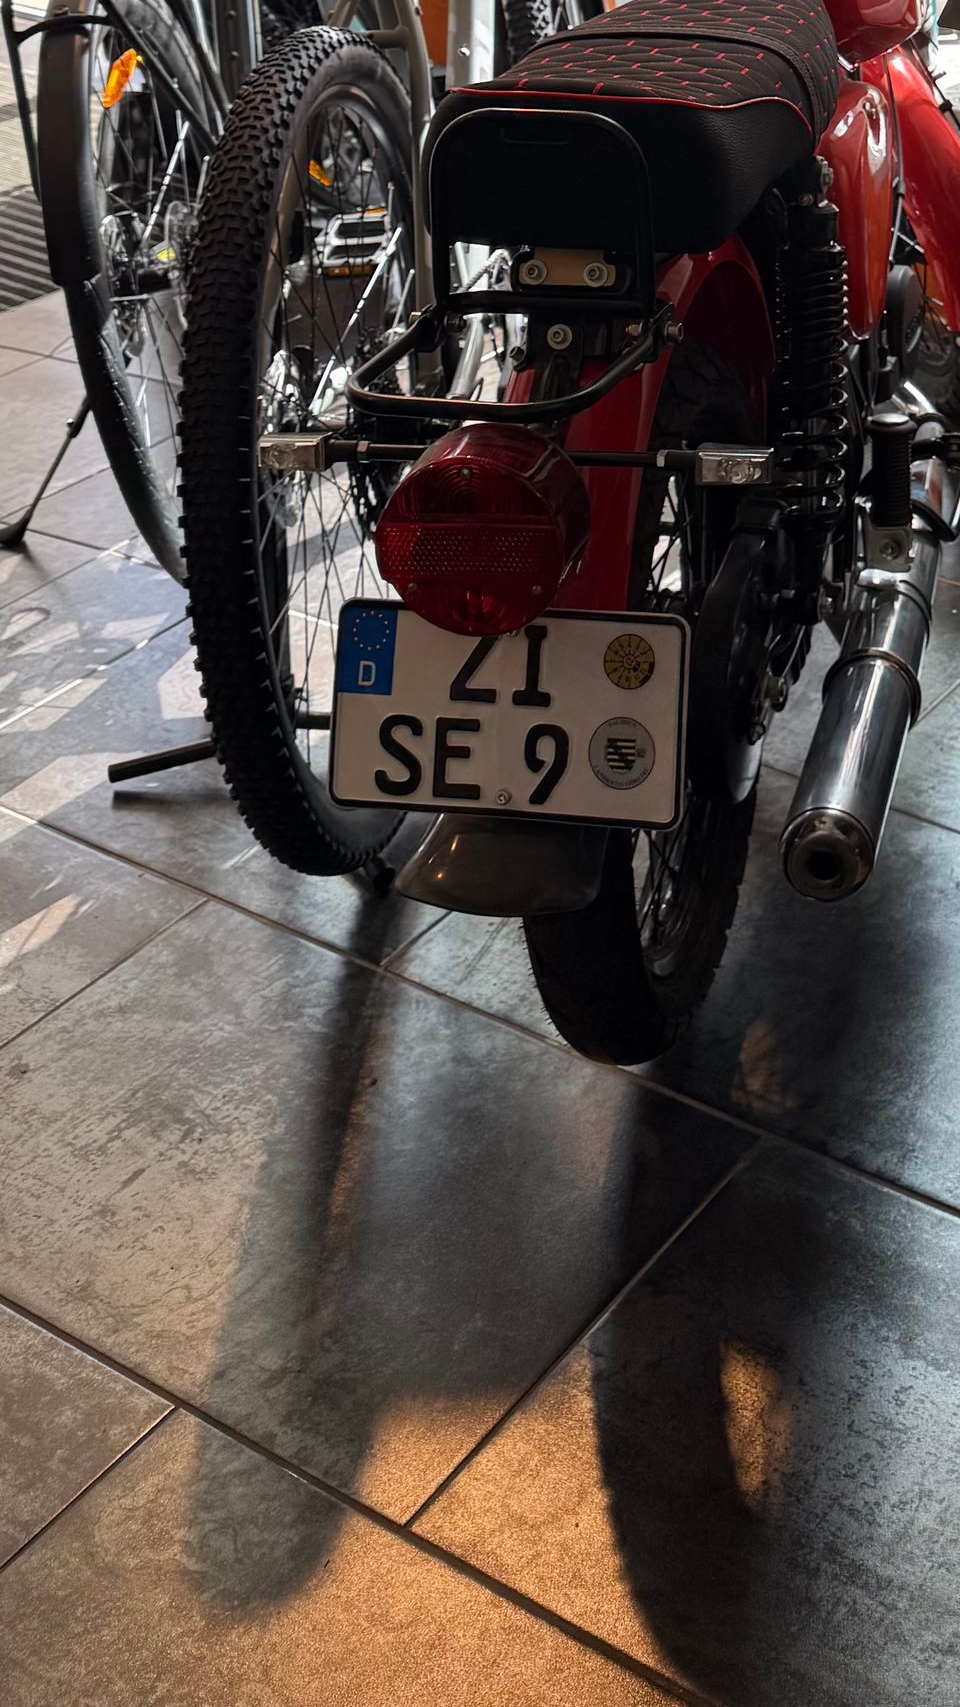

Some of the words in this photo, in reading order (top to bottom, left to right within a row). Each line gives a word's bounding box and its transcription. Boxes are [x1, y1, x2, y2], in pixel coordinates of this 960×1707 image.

[356, 660, 376, 686] D
[374, 714, 482, 801] SE
[523, 723, 570, 805] 9
